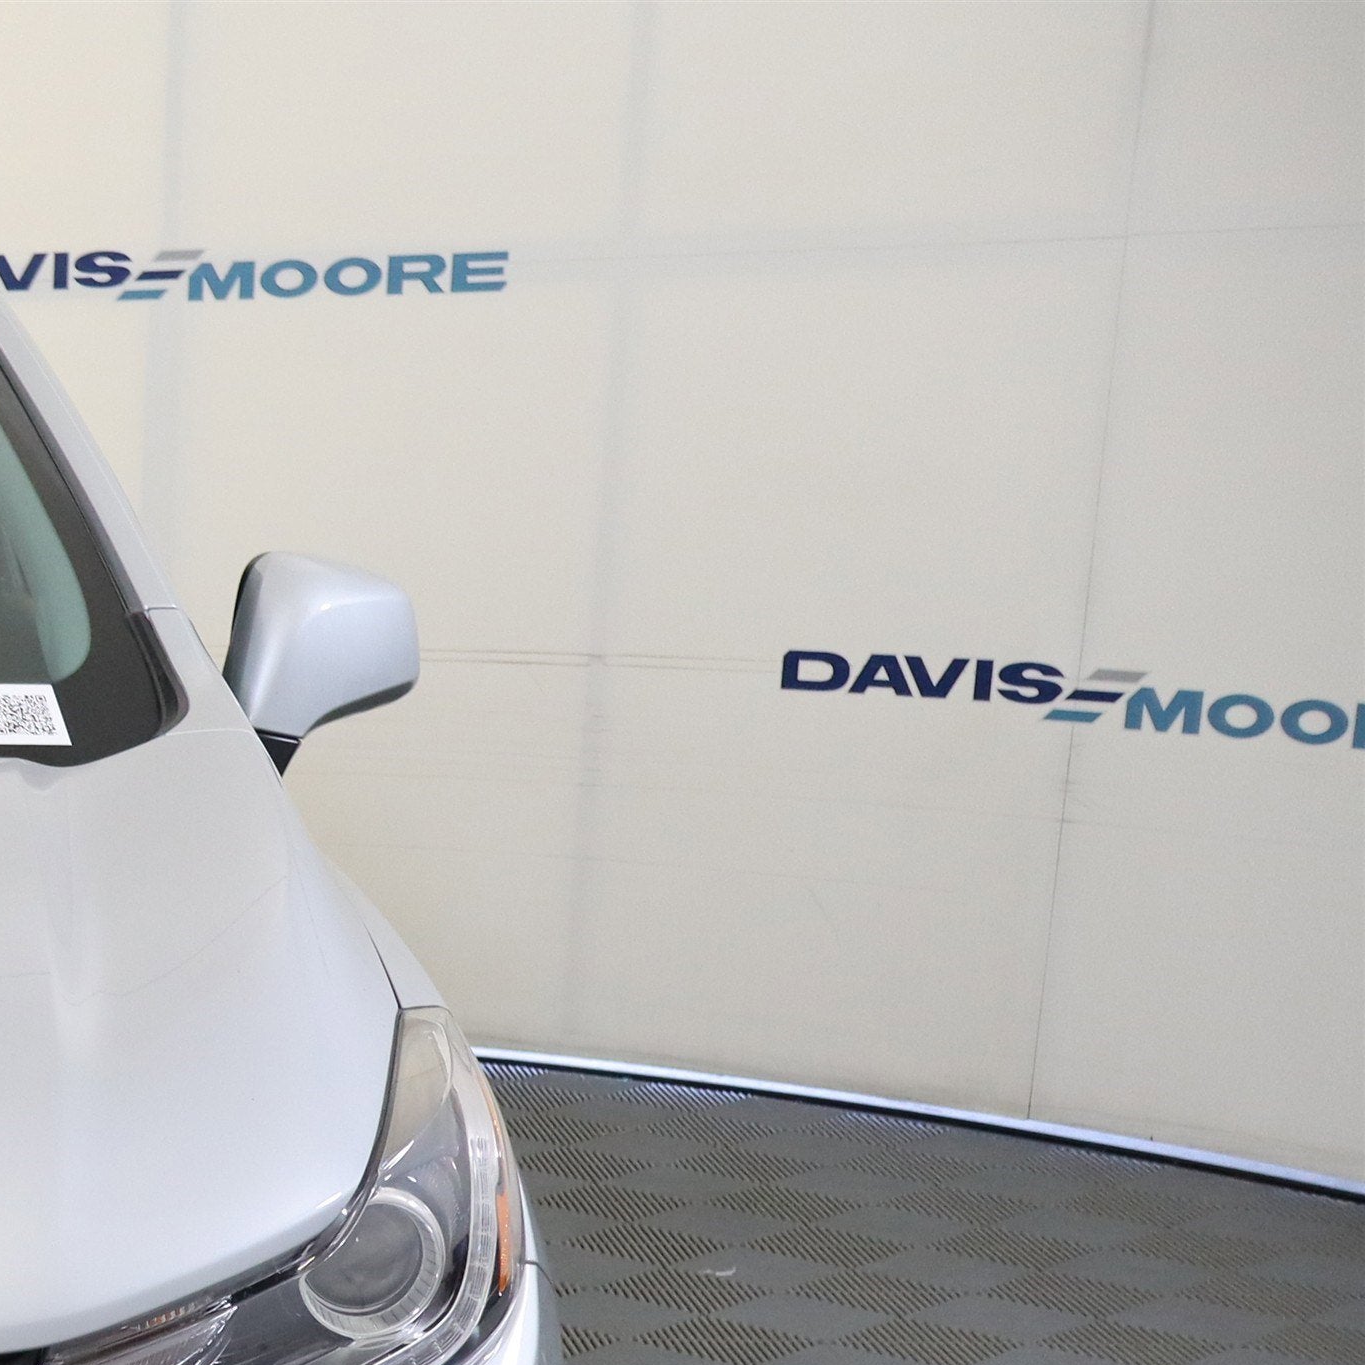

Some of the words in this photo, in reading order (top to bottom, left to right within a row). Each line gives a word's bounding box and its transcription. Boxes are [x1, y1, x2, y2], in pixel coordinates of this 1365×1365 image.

[187, 251, 509, 301] MOORE
[780, 650, 1066, 705] DAVIS
[1124, 687, 1365, 749] MOO
